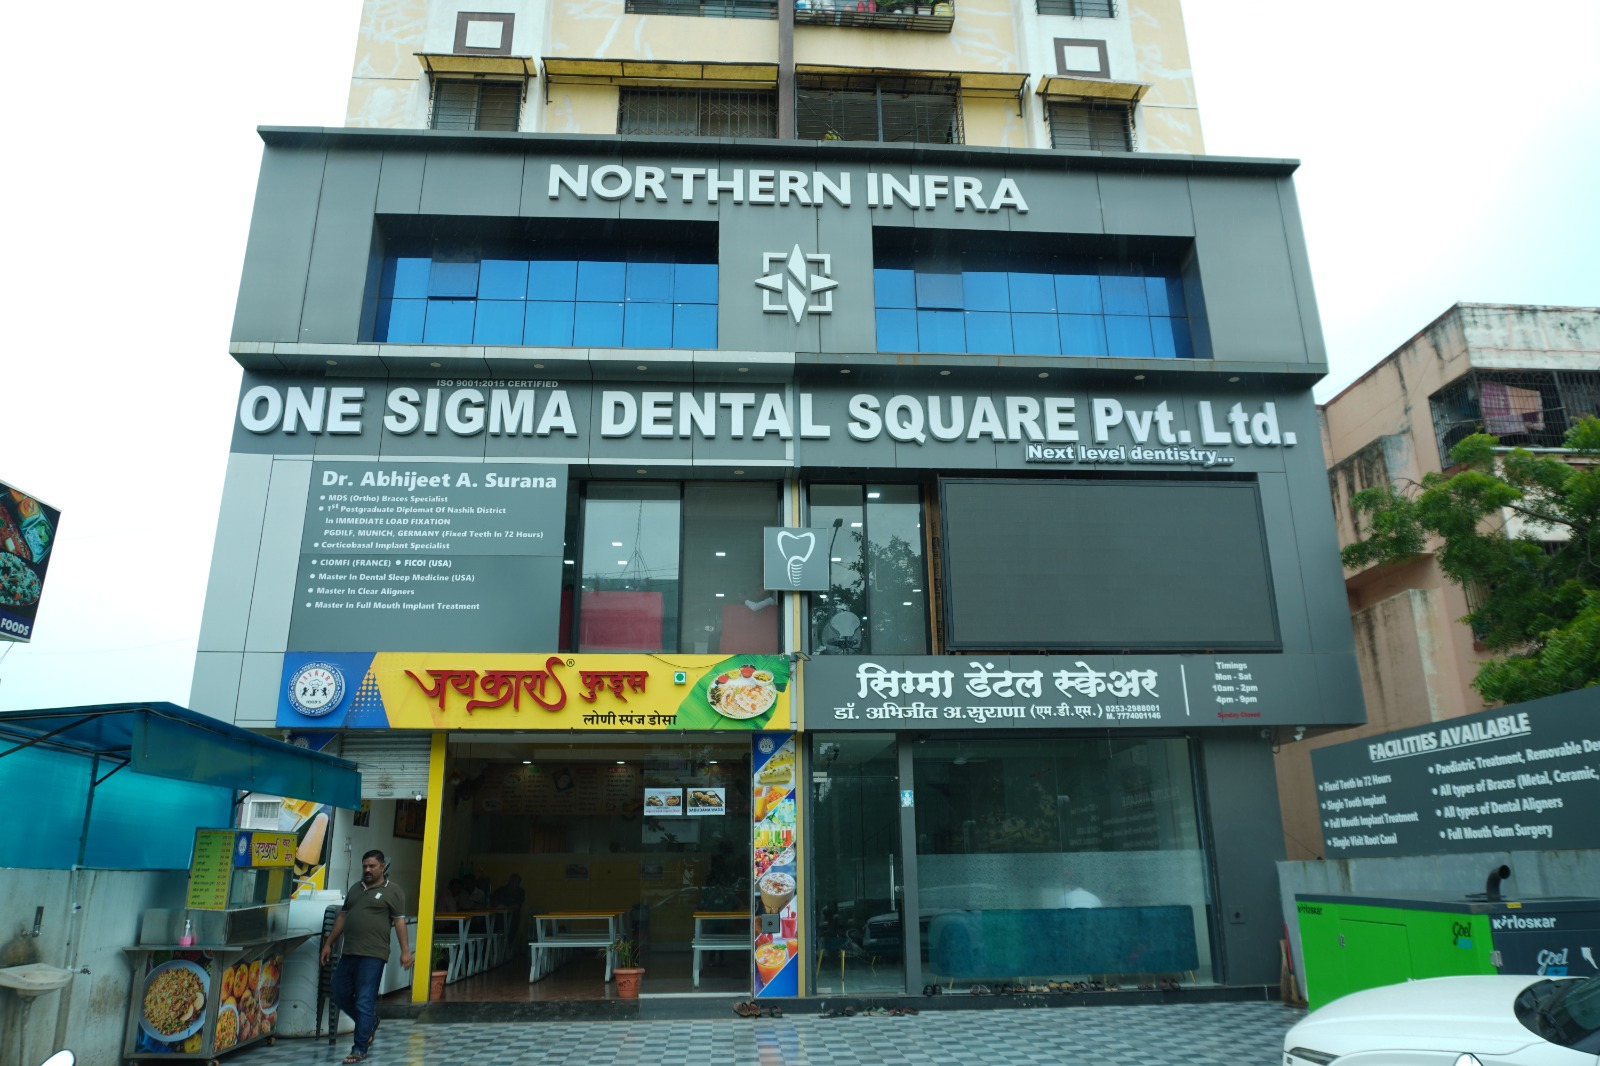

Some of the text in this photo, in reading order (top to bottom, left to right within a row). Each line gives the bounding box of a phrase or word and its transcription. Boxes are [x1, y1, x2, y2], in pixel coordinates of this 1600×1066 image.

[548, 164, 1029, 214] NORTHERN INFRA
[436, 379, 559, 388] ISO 9001:2015 CERTIFIED
[239, 386, 1297, 448] ONE SIGMA DENTAL SQUARE Pvt. Ltd.
[1026, 443, 1235, 468] Next level dentistry...
[322, 471, 557, 491] Dr. Abhijeet A. Surana
[328, 494, 448, 504] MDS (Ortho) Braces Specialist
[340, 505, 394, 515] Postgraduate
[397, 506, 434, 515] Diplomat
[447, 506, 475, 514] Nashik
[335, 517, 384, 525] IMMEDIATE
[324, 529, 355, 538] PGDILF,
[358, 530, 395, 538] MUNICH,
[441, 530, 467, 538] (Fixed
[469, 530, 492, 538] Teeth
[516, 531, 544, 539] Hours)
[321, 541, 450, 550] Corticobasal Implant Specialist
[352, 559, 391, 567] (FRANCE)
[404, 559, 426, 567] FICOI
[388, 574, 410, 582] Sleep
[380, 588, 415, 596] Aligners
[402, 602, 435, 611] Implant
[1, 617, 30, 636] FOODS
[1215, 662, 1248, 671] Timings
[856, 660, 1159, 699] सिग्मा डेंटल स्केअर
[1215, 673, 1232, 681] Mon
[1238, 673, 1252, 681] Sat
[1212, 684, 1234, 692] 10am
[1240, 684, 1258, 693] 2pm
[1215, 696, 1234, 705] 4pm
[1240, 696, 1257, 704] 9pm
[833, 702, 859, 720] डॉ.
[866, 702, 938, 720] अभिजीत
[1105, 704, 1160, 712] 0253-2988001
[583, 711, 677, 727] लोणी स्पंज डोसा
[1106, 712, 1115, 720] M.
[1368, 712, 1531, 760] FACILITIES AVAILABLE
[1435, 758, 1475, 775] Paediatric
[1476, 751, 1526, 768] Treatment,
[1525, 741, 1582, 761] Removable
[1324, 775, 1392, 792] Fixed Teeth In 72 Hours
[1440, 766, 1599, 798] All types of Braces (Metal, Ceramic,
[1326, 794, 1387, 812] Single Tooth Implant
[1444, 797, 1564, 820] All types of Dental Aligners
[1330, 811, 1419, 829] Full Mouth Implant Treatment
[1446, 823, 1553, 840] Full Mouth Gum Surgery
[1332, 832, 1397, 849] Single Visit Root Canal
